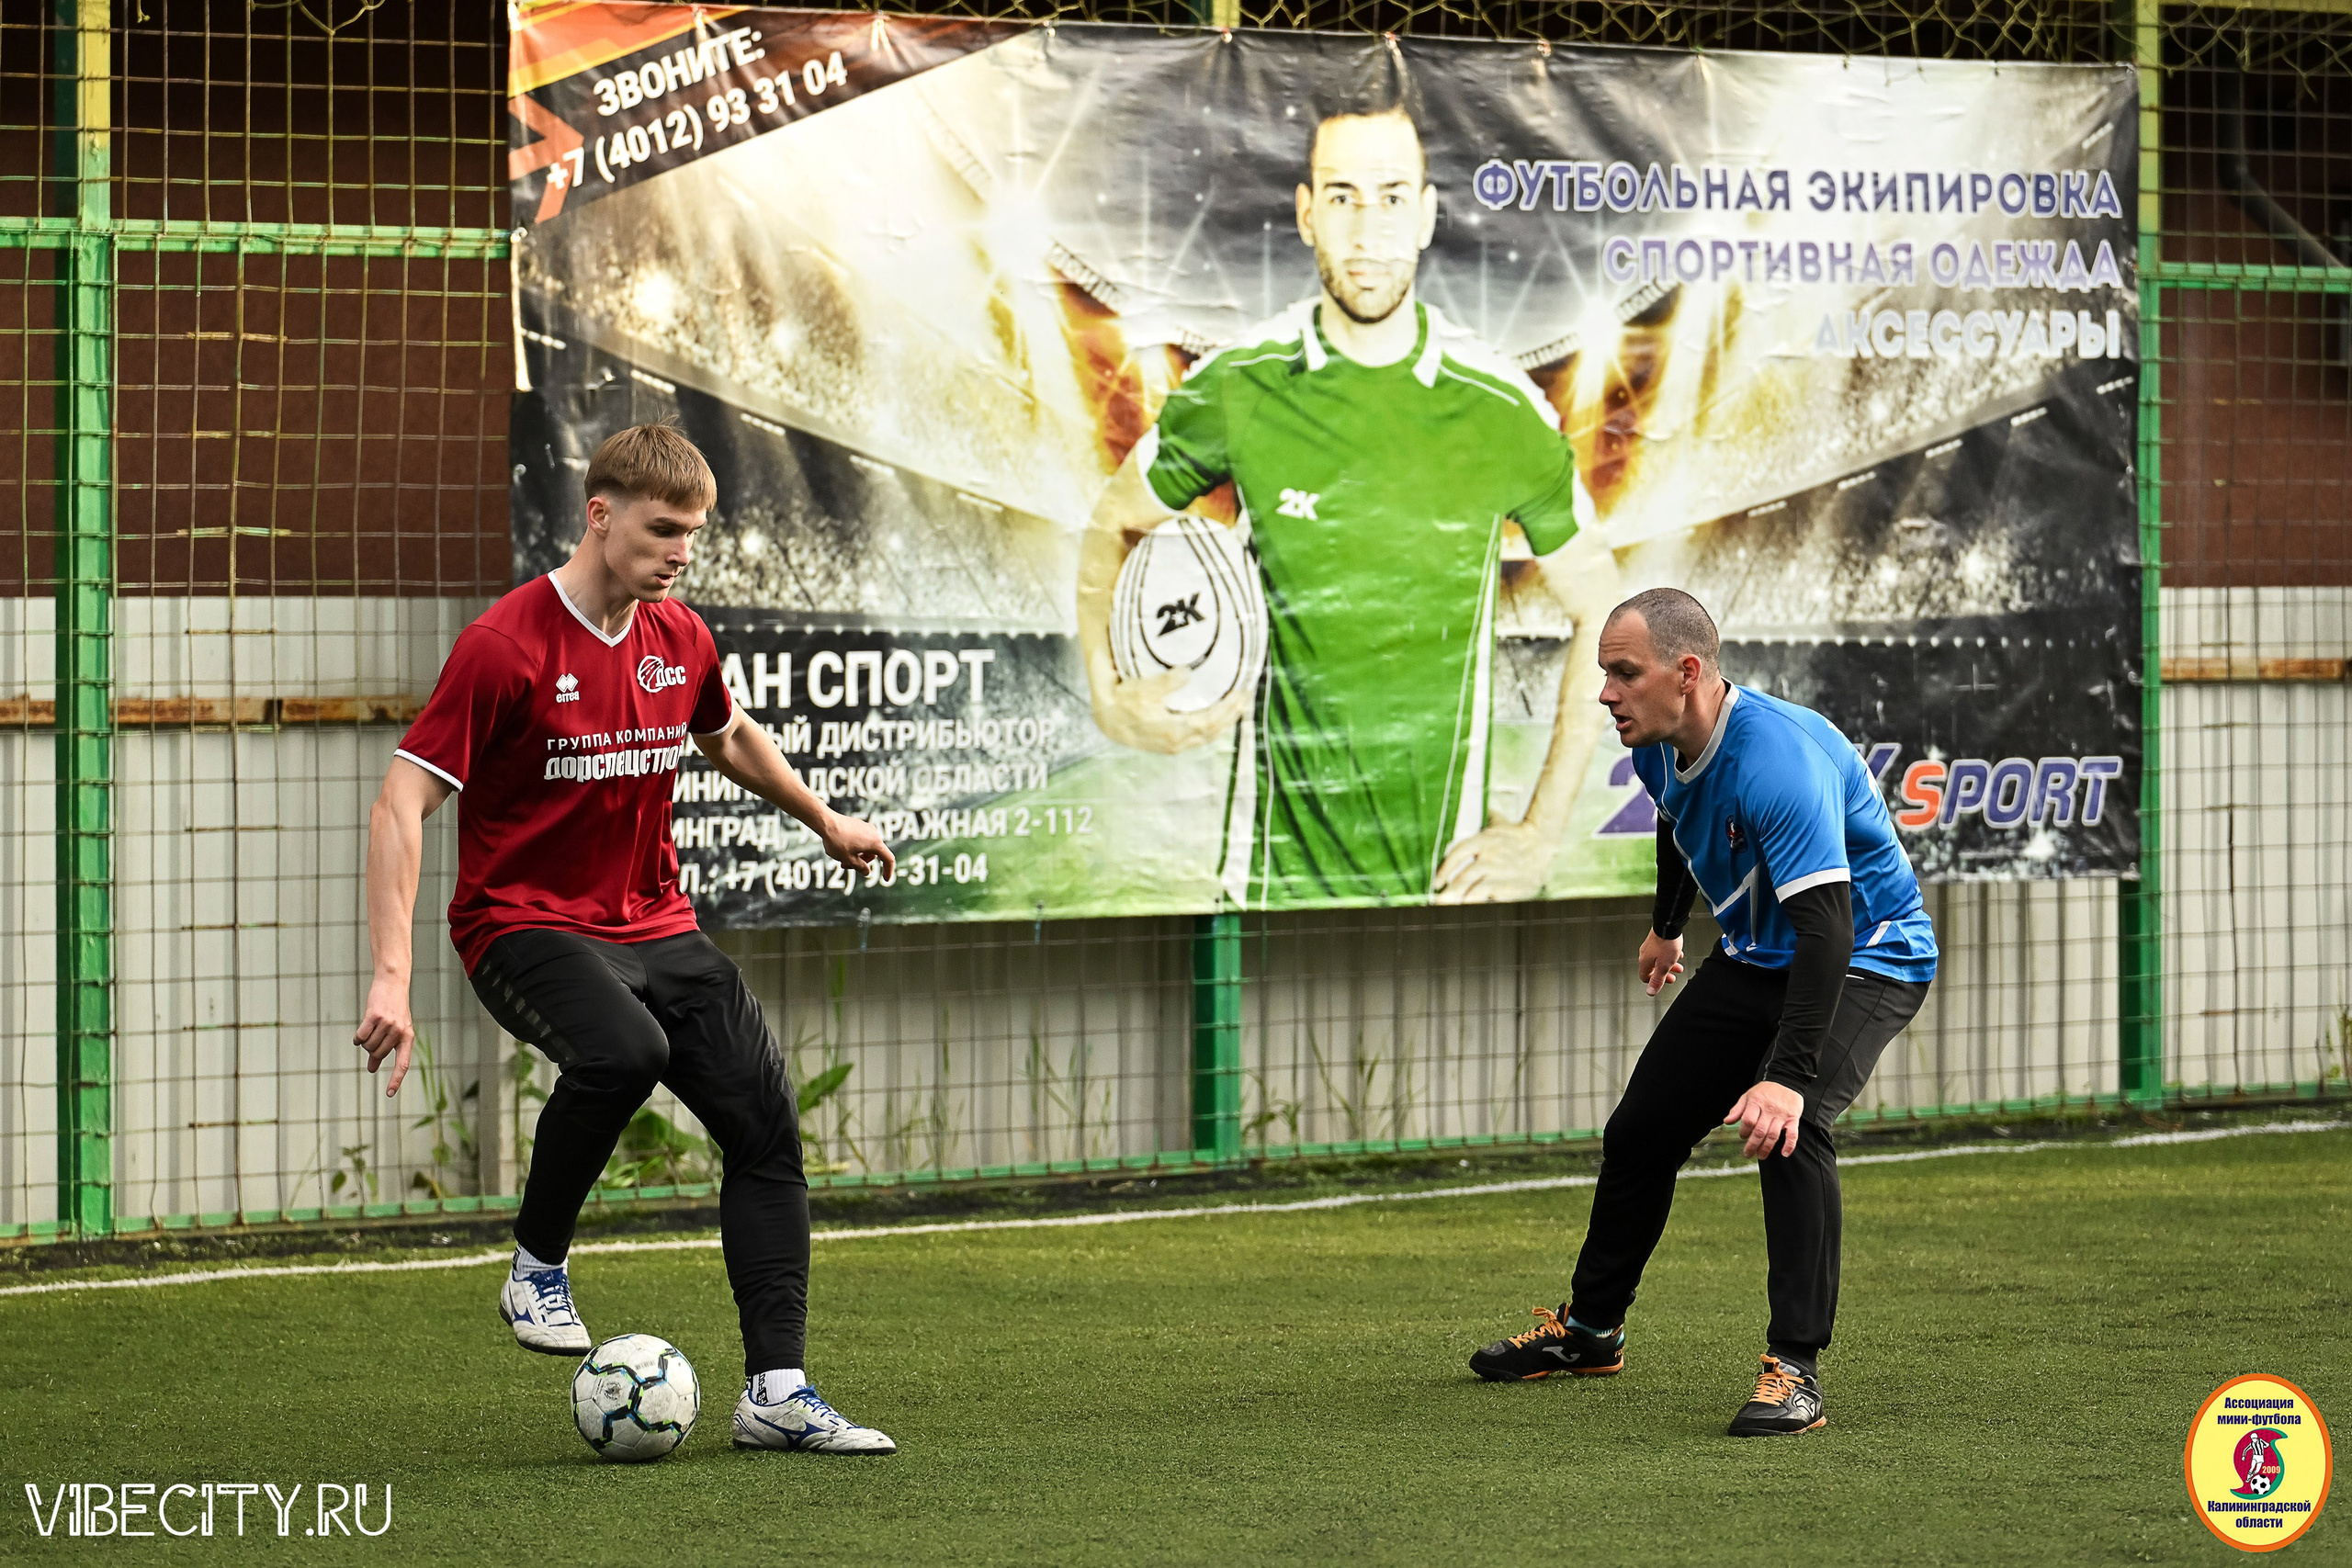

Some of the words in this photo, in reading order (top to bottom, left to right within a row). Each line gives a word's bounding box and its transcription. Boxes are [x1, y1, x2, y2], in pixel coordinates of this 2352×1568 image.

[594, 27, 766, 117] ЗВОНИТЕ:
[546, 147, 584, 189] +7
[595, 105, 705, 183] (4012)
[707, 88, 752, 133] 93
[757, 71, 797, 114] 31
[803, 51, 847, 96] 04
[1474, 161, 1792, 213] ФУТБОЛЬНАЯ
[1807, 170, 2121, 219] ЭКИПИРОВКА
[1604, 236, 1913, 288] СПОРТИВНАЯ
[1930, 239, 2122, 291] ОДЕЖДА
[1815, 310, 2120, 359] АКСЕССУАРЫ
[1276, 487, 1320, 522] 2K
[1156, 592, 1205, 637] 2K
[808, 649, 996, 709] СПОРТ
[547, 732, 612, 750] ГРУППА
[616, 721, 687, 745] КОМПАНИЙ
[816, 716, 1056, 760] ДИСТРИБЬЮТОР
[912, 761, 1048, 795] ОБЛАСТИ
[1896, 755, 2122, 830] SPORT
[1013, 806, 1093, 837] 2-112
[724, 860, 759, 892] +7
[765, 858, 856, 898] (4012)
